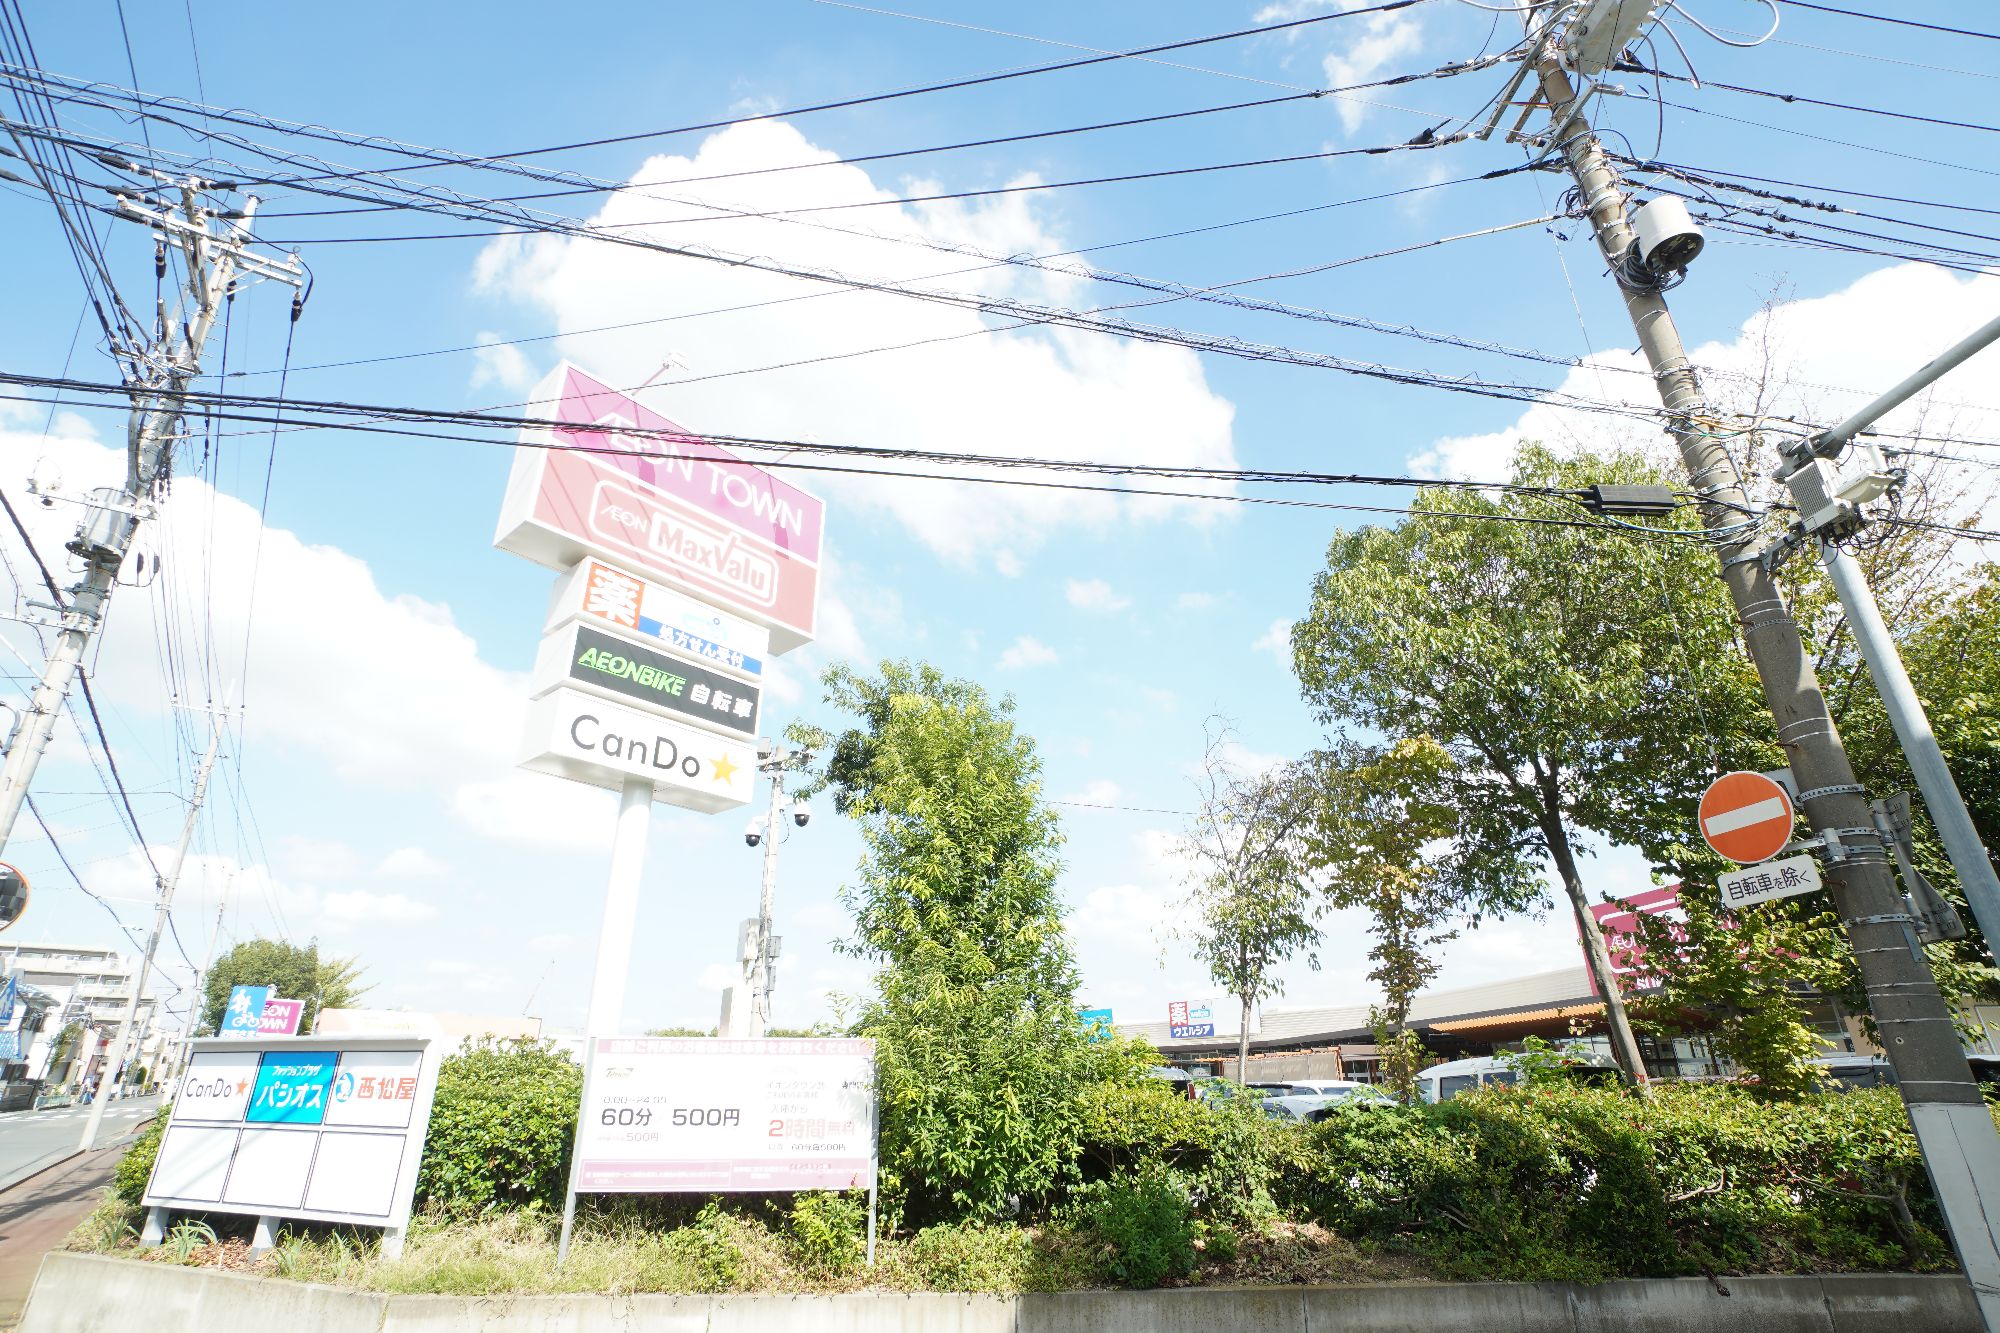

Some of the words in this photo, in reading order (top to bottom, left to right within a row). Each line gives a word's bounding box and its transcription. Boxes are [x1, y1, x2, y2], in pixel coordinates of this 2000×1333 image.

[706, 462, 802, 536] TOWN
[660, 519, 767, 590] MaxValu
[587, 566, 640, 627] 薬
[577, 648, 687, 697] AEONBIKE
[690, 684, 753, 718] 自転車
[570, 714, 700, 778] CanDo
[1727, 866, 1812, 901] 自転車を除く
[1170, 1002, 1188, 1026] 薬
[1173, 1024, 1210, 1038] ウエルシア
[185, 1077, 232, 1099] CanDo
[255, 1081, 324, 1110] パシオス
[356, 1077, 417, 1101] 西松屋
[601, 1107, 653, 1127] 60分
[671, 1108, 740, 1127] 500円
[626, 1132, 659, 1142] 500円
